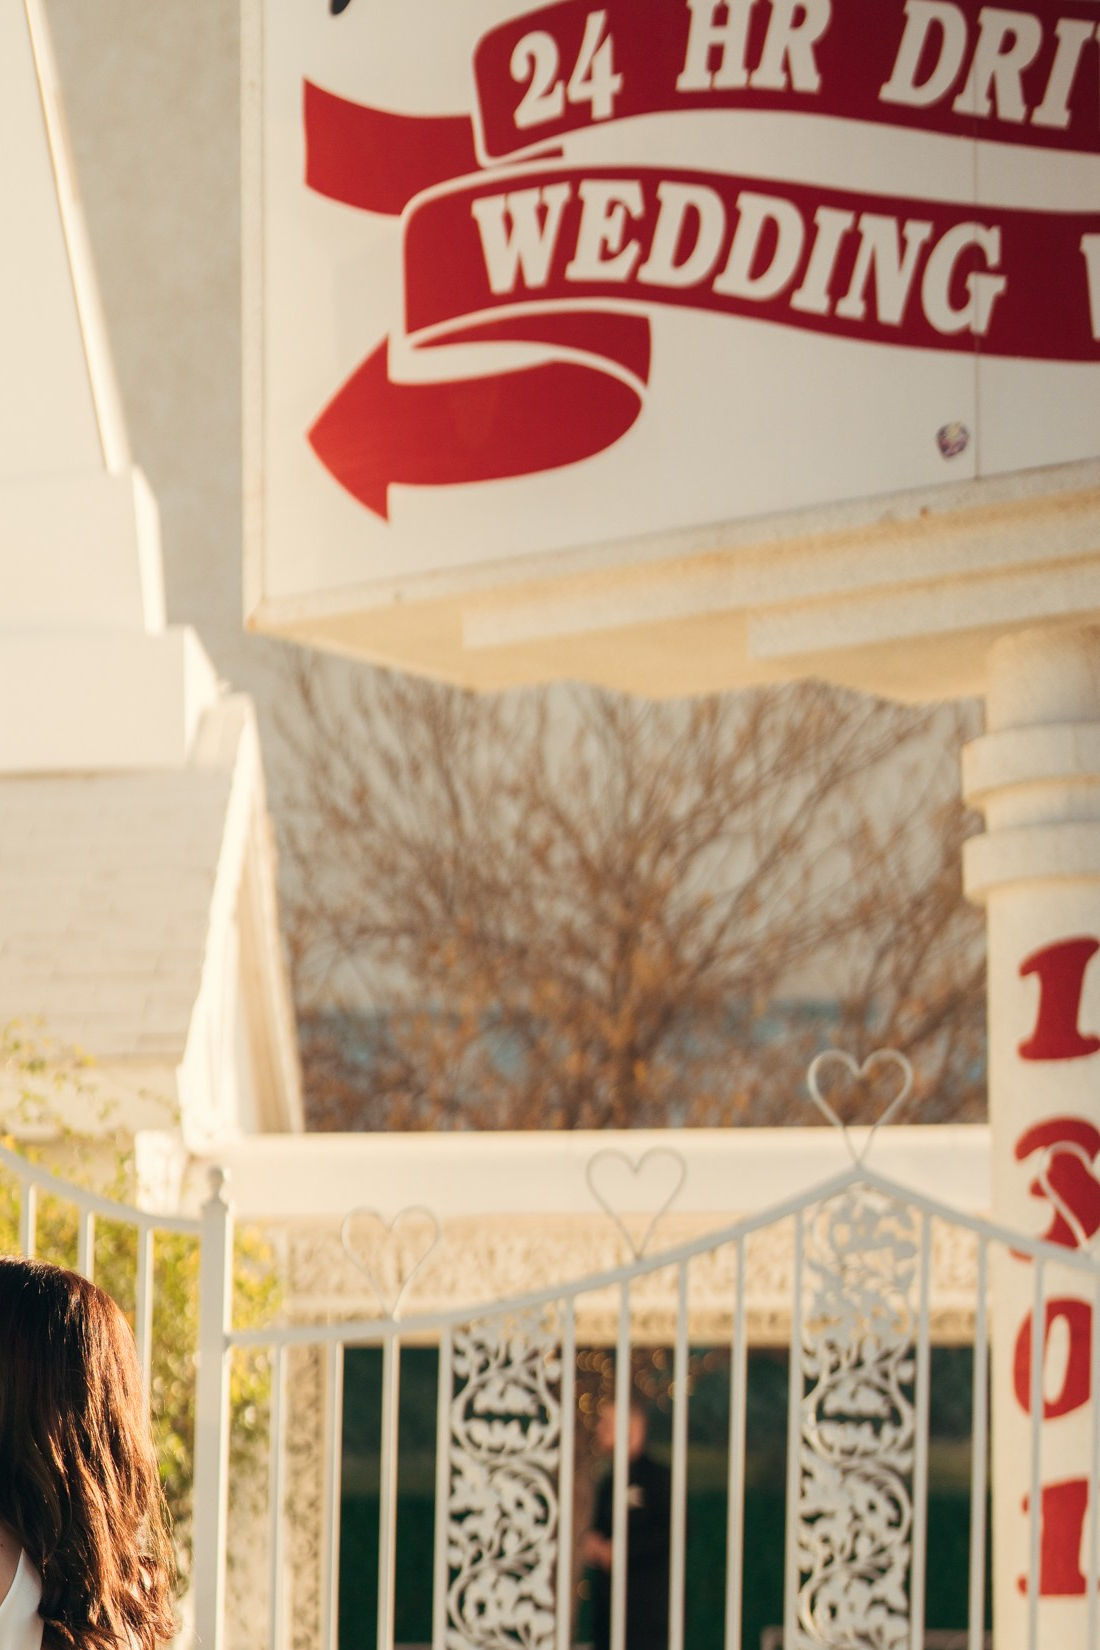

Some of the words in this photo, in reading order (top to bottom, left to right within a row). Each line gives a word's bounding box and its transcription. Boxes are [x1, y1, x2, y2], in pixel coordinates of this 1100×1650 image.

[510, 9, 623, 128] 24
[676, 0, 831, 93] HR
[879, 0, 1100, 129] DRI
[471, 179, 1007, 336] WEDDING
